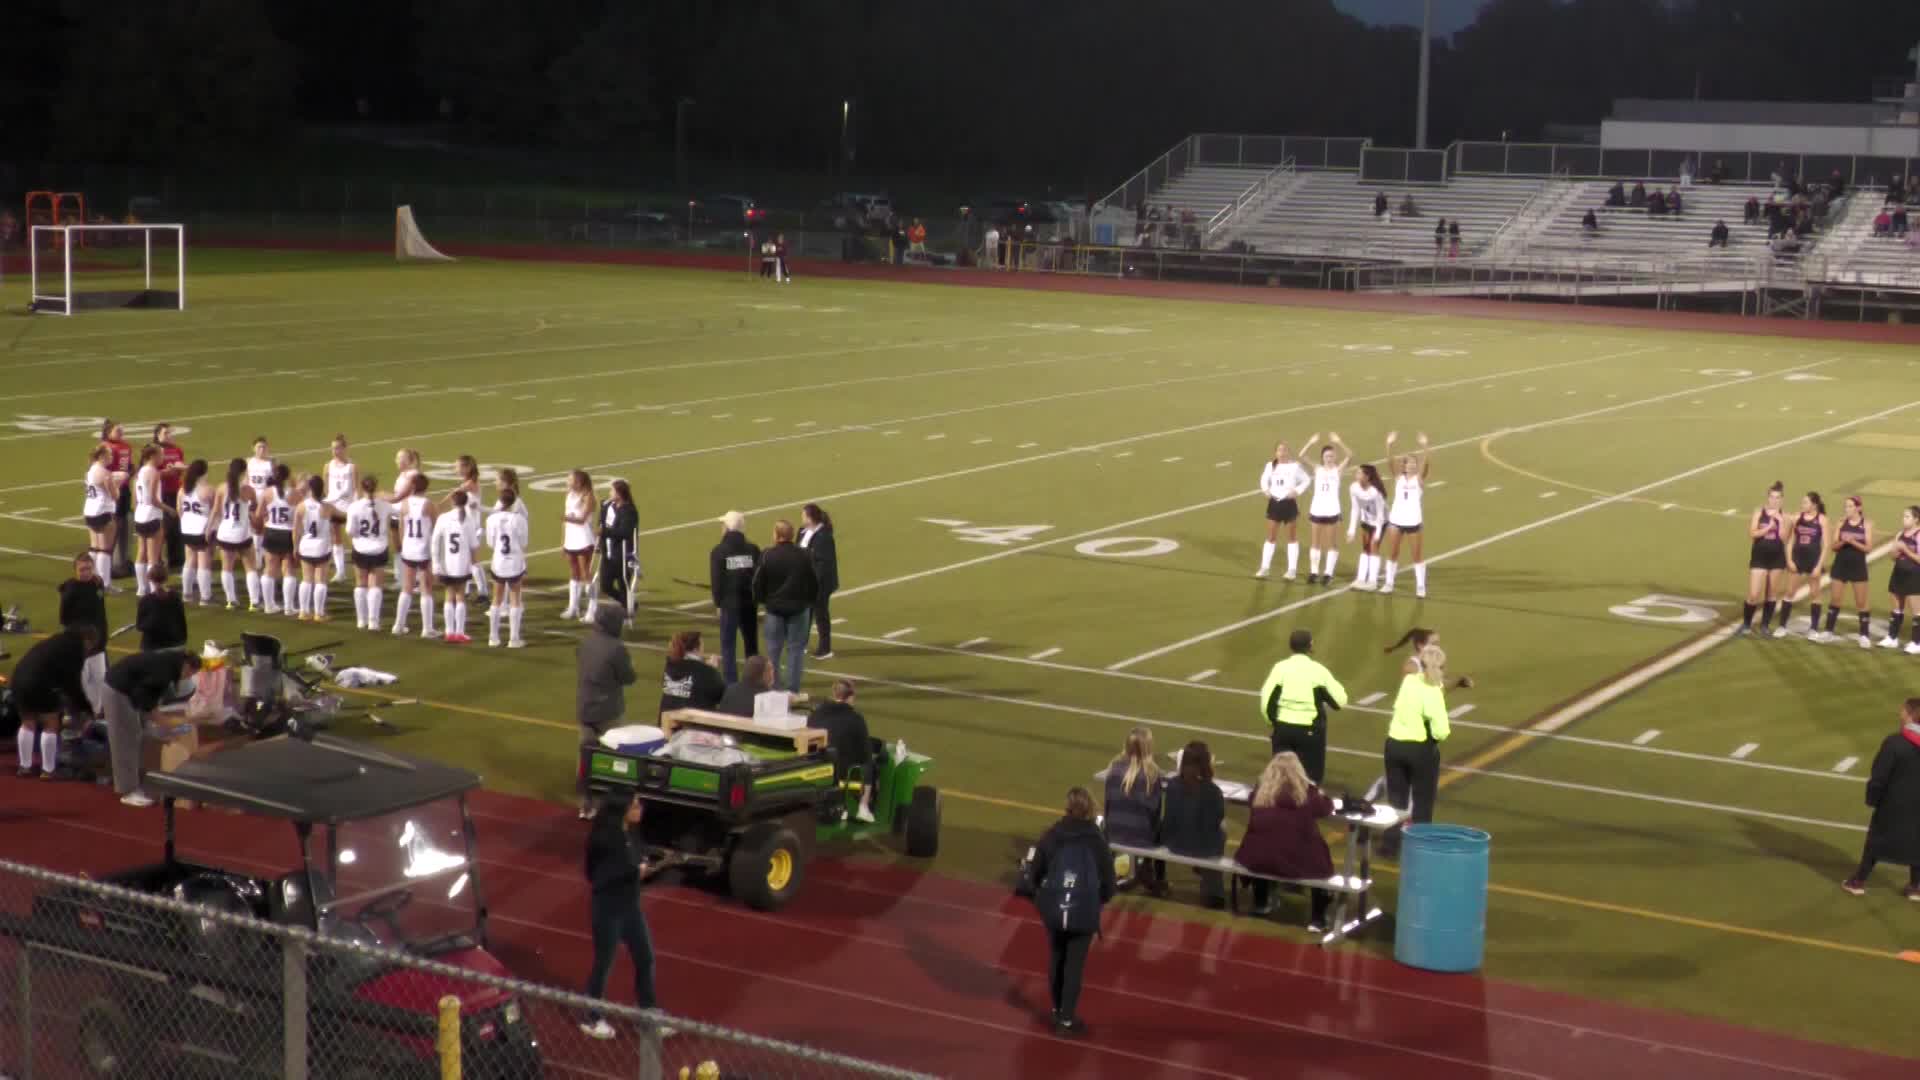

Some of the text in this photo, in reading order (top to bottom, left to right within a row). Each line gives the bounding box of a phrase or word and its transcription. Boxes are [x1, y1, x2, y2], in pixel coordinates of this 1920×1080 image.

[270, 506, 290, 524] 15
[308, 520, 318, 538] 4
[359, 518, 381, 538] 24
[407, 518, 424, 539] 11
[449, 532, 461, 555] 5
[500, 532, 511, 556] 3
